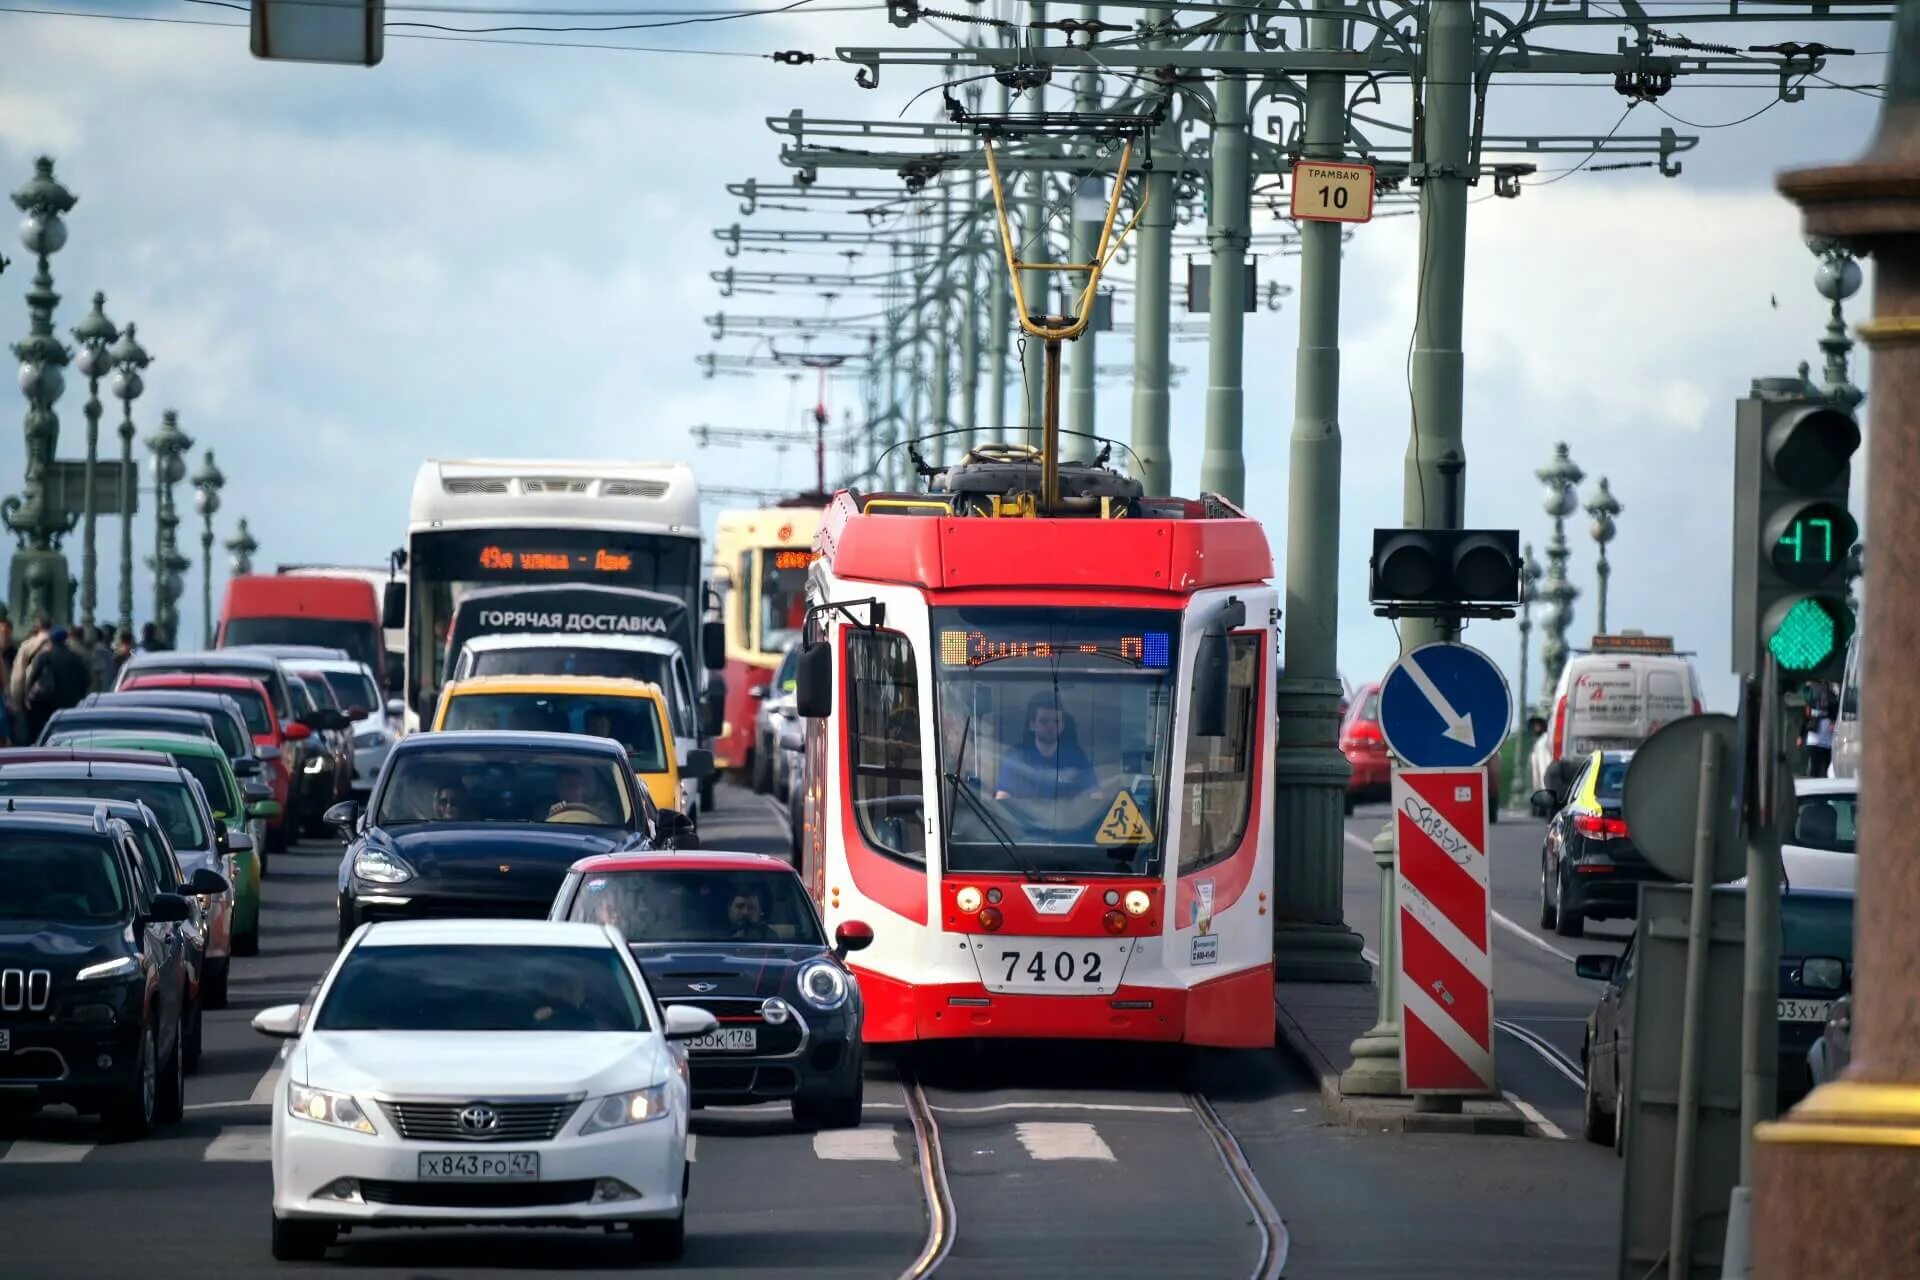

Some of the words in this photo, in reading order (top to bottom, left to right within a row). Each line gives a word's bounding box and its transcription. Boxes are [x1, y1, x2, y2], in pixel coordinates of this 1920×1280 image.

[1308, 169, 1360, 181] ТРАМВАЮ
[1318, 186, 1348, 209] 10
[1777, 519, 1830, 562] 47
[479, 611, 562, 628] ГОРЯЧАЯ
[565, 613, 667, 632] ДОСТАВКА
[927, 817, 933, 834] 1
[1001, 951, 1102, 982] 7402
[729, 1030, 752, 1042] 178
[513, 1154, 530, 1169] 47
